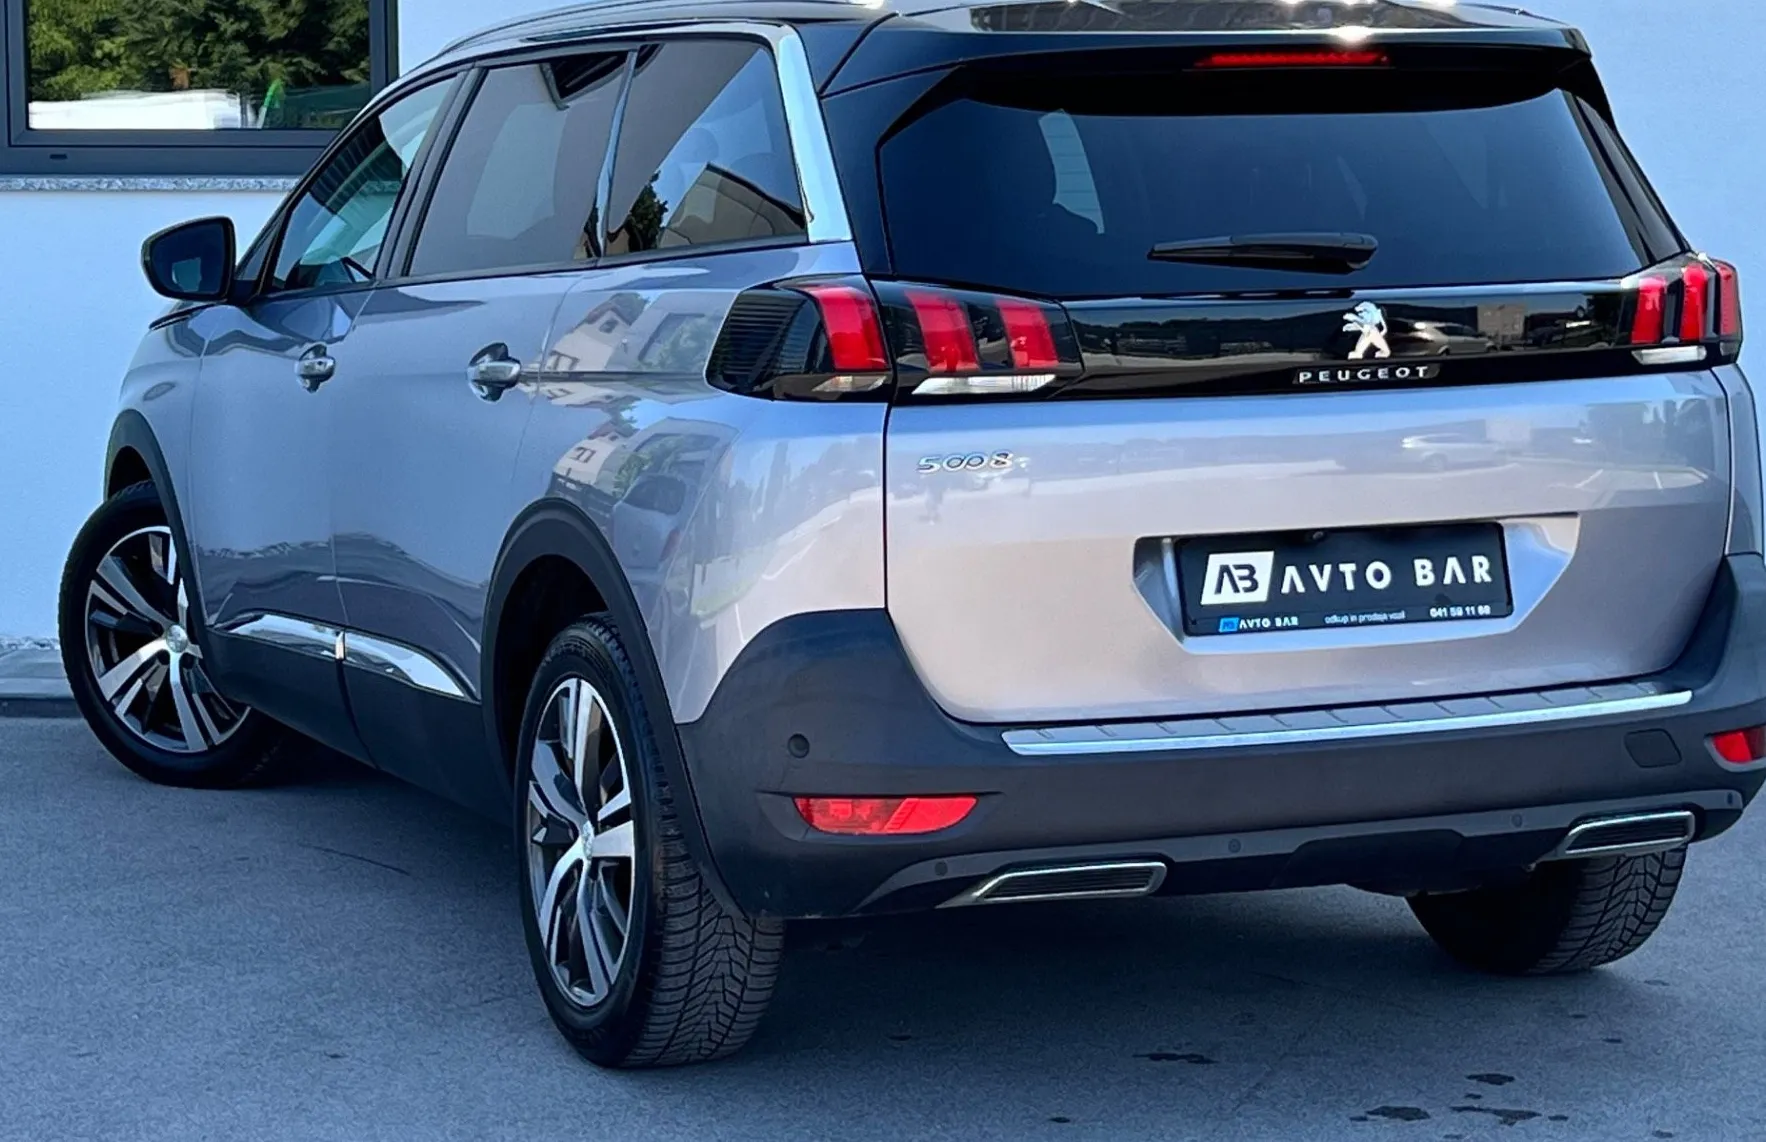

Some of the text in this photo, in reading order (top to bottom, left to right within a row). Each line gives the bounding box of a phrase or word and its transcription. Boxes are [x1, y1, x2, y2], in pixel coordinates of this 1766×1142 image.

[1299, 366, 1429, 384] PEUGEOT
[918, 450, 1014, 473] 5008
[1281, 555, 1492, 594] AVTO BAR
[1429, 607, 1448, 618] 041
[1464, 605, 1476, 616] 11
[1239, 616, 1299, 629] AVTO BAR
